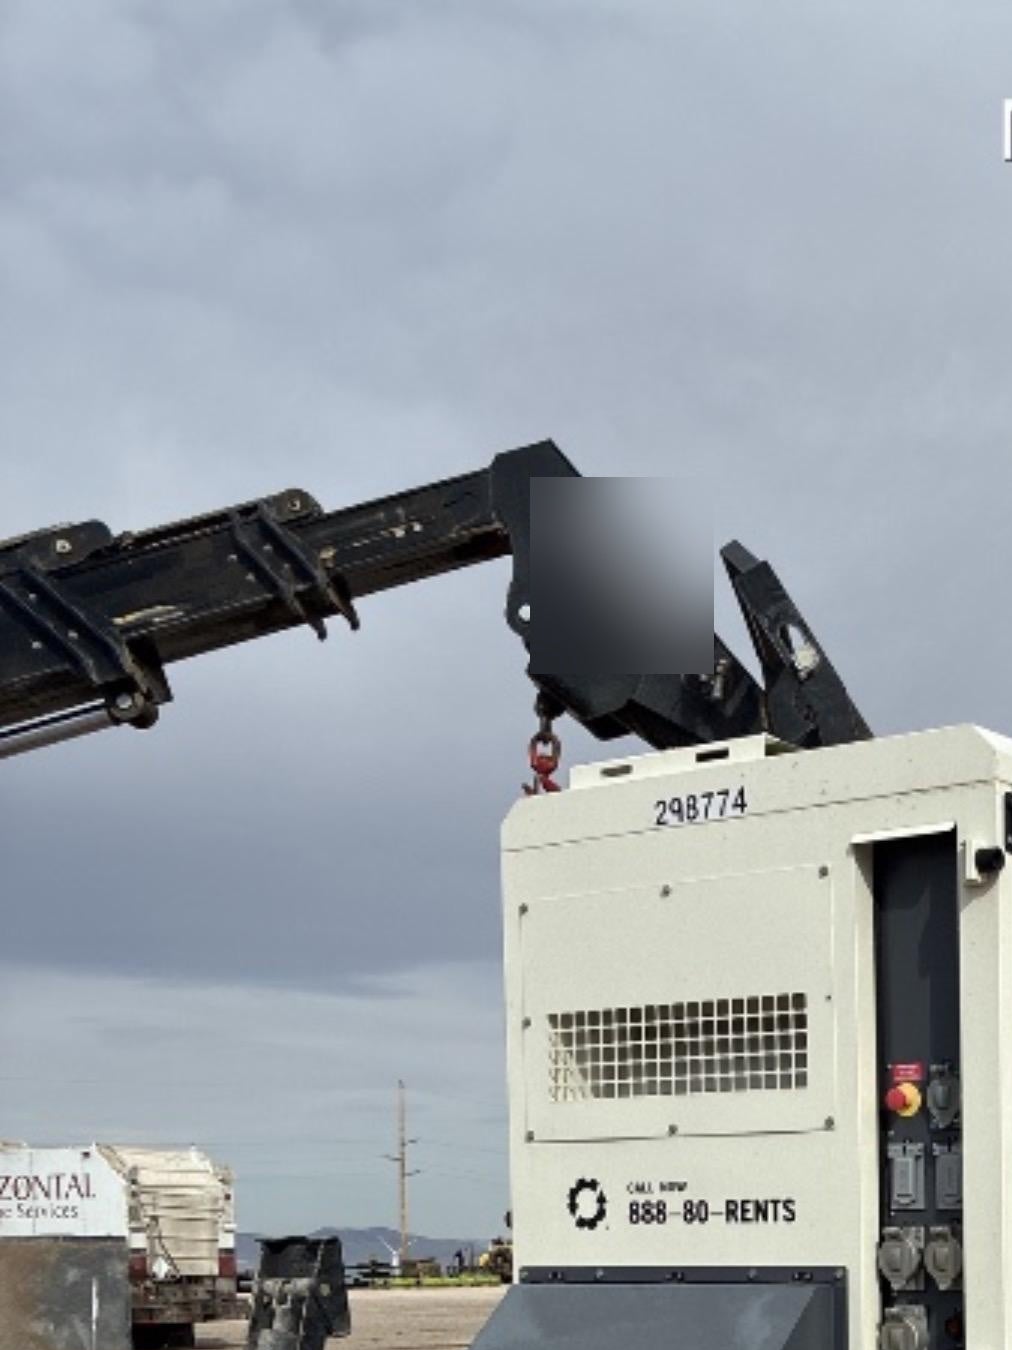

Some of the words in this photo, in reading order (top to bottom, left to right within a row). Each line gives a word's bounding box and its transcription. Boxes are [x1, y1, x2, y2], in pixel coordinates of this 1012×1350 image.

[654, 785, 748, 826] 298774
[627, 1182, 653, 1195] CALL
[629, 1198, 796, 1225] 888-80-RENTS
